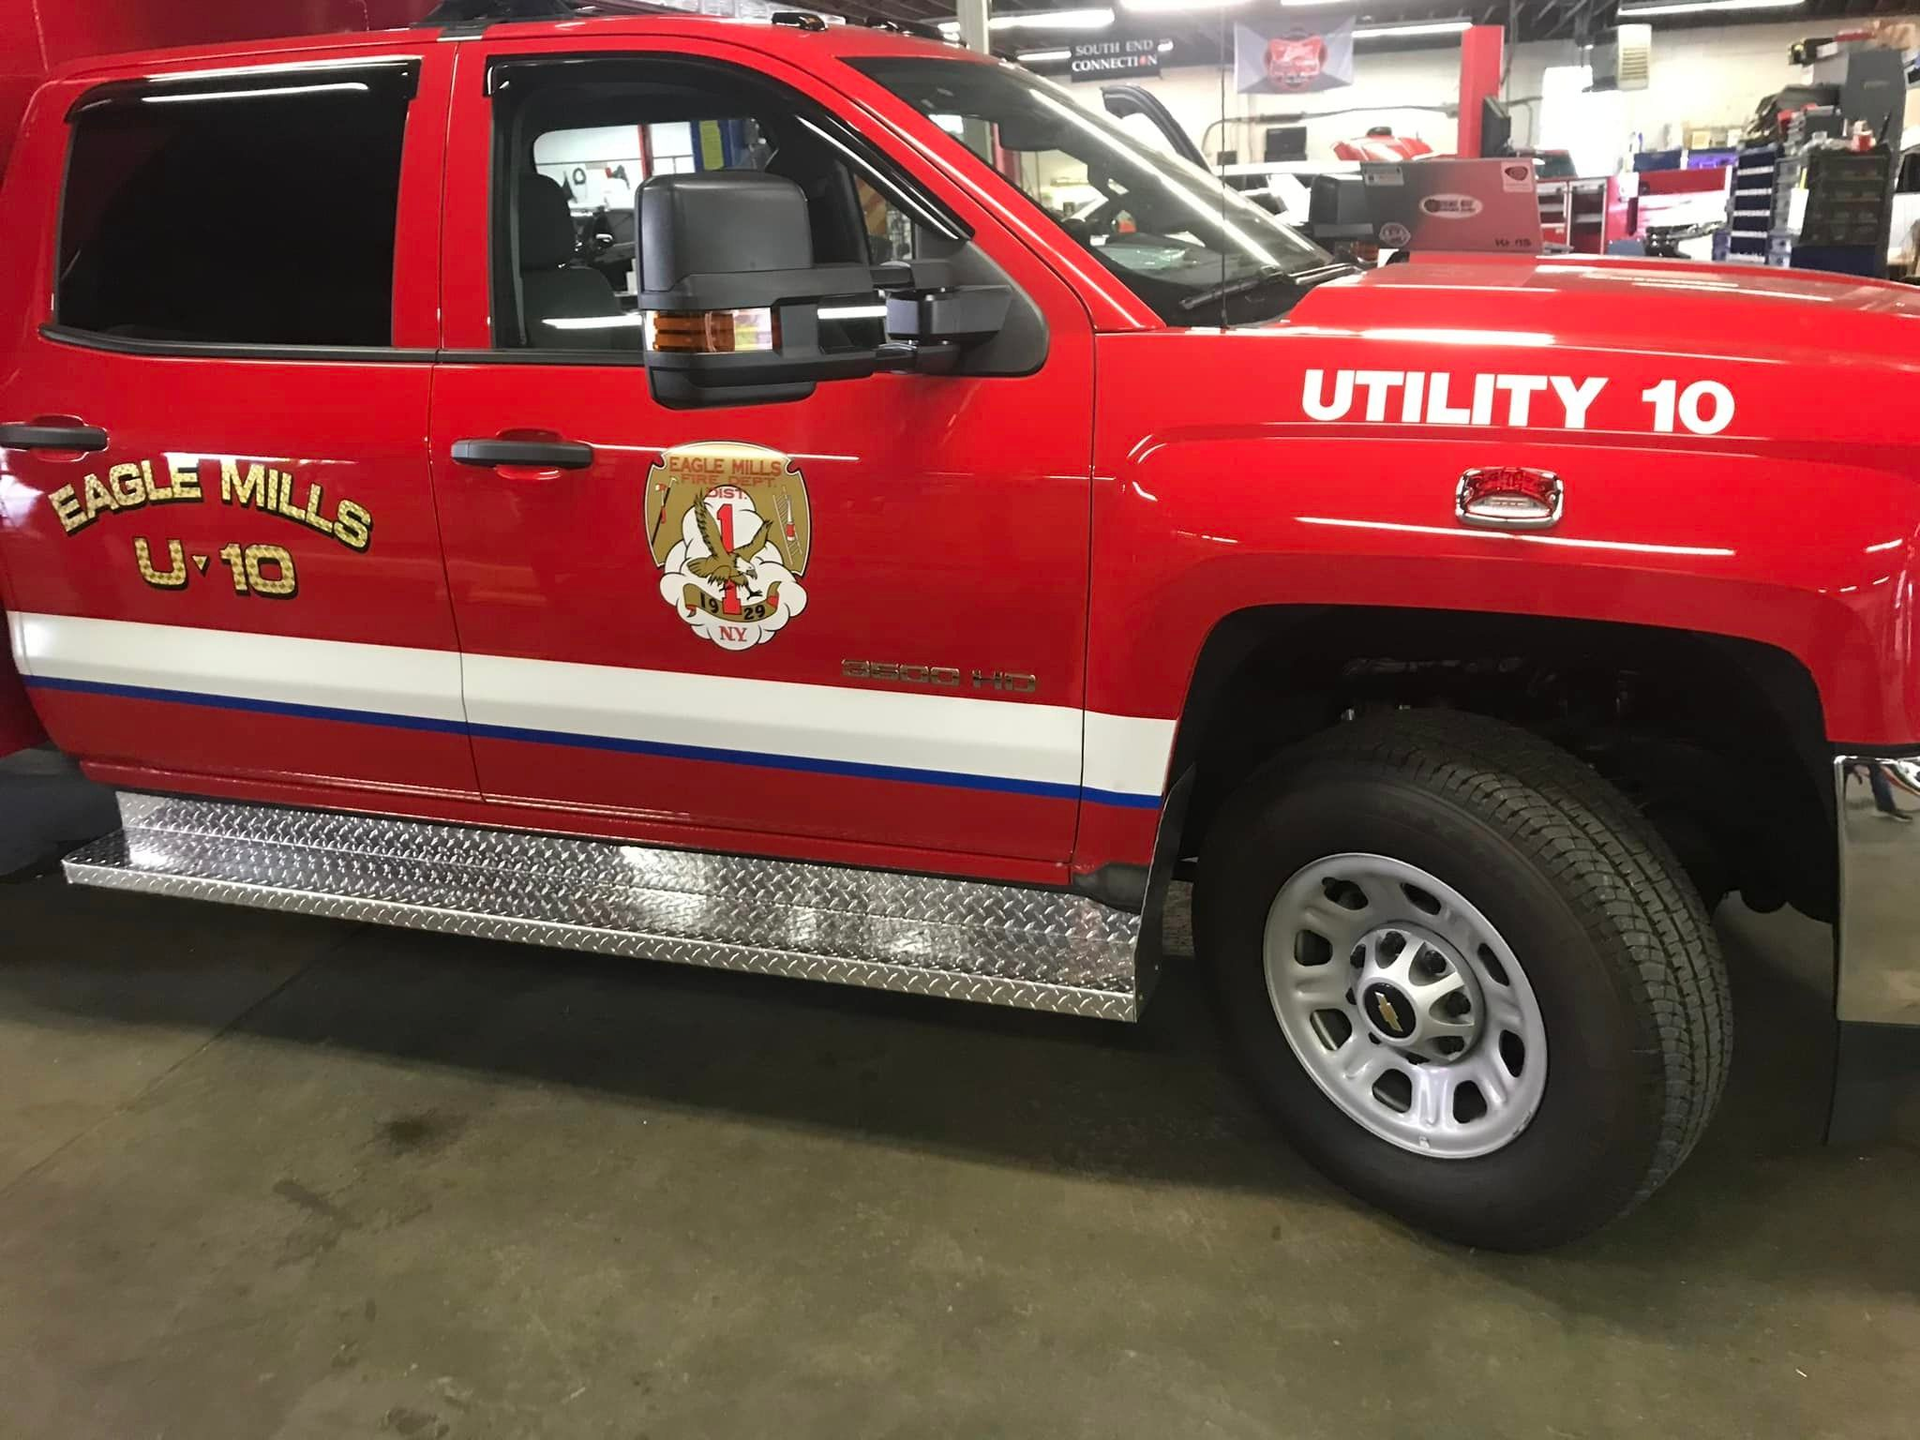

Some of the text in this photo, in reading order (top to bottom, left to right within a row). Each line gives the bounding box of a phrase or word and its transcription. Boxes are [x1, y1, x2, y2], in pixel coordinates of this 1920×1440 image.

[1075, 40, 1154, 56] SOUTH END
[1302, 369, 1735, 435] UTILITY 10
[669, 457, 782, 476] EAGLE MILLS
[681, 474, 777, 489] FIRE DEPT.
[706, 488, 748, 500] DIST.
[48, 457, 373, 553] EAGLE MILLS
[719, 625, 748, 642] NY
[841, 659, 1036, 693] 3500 HD
